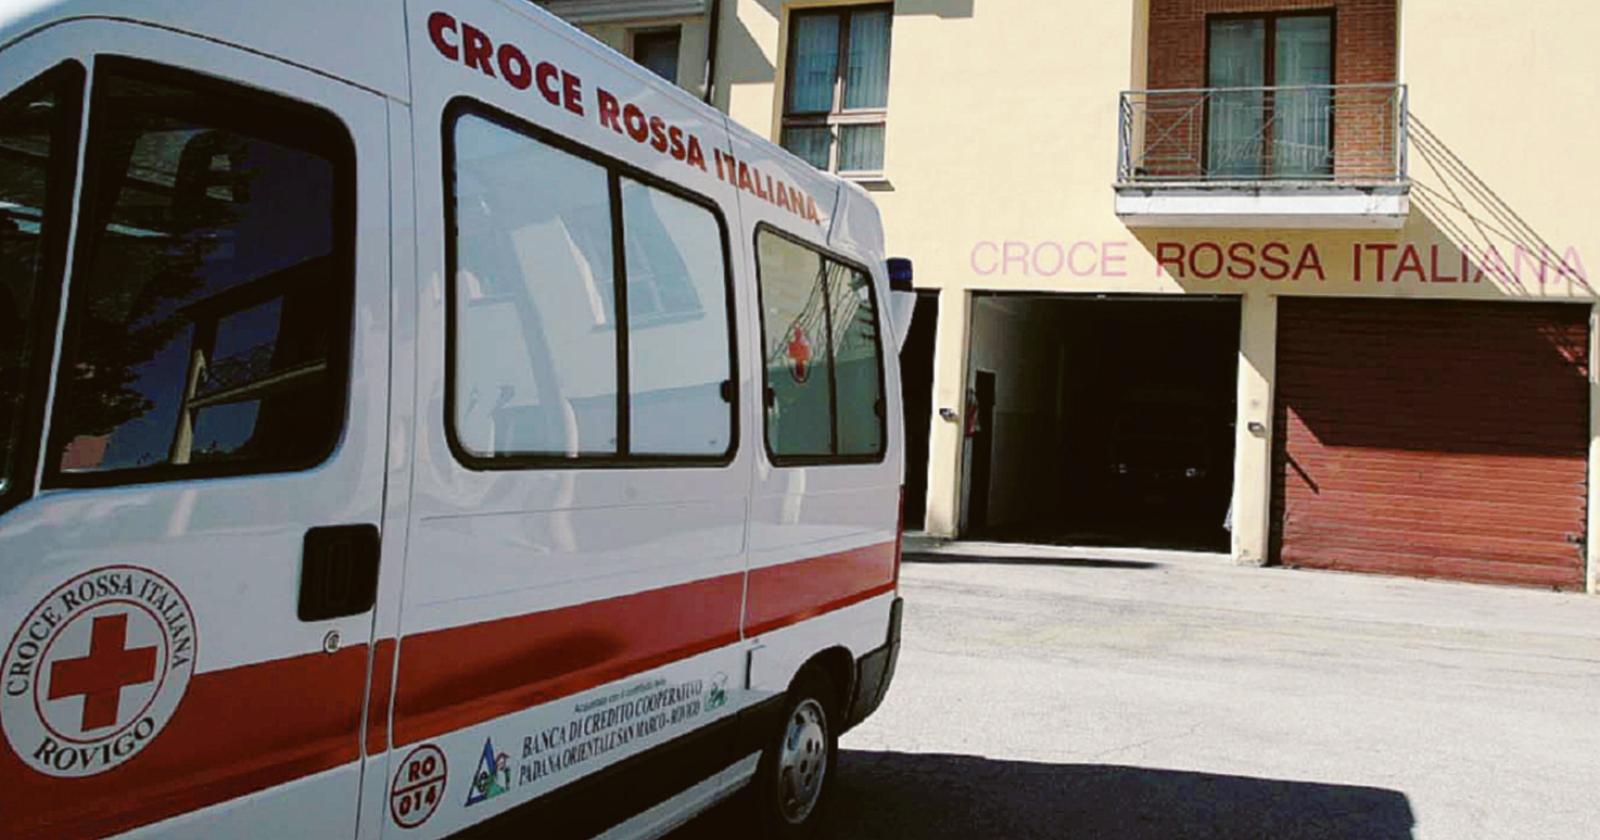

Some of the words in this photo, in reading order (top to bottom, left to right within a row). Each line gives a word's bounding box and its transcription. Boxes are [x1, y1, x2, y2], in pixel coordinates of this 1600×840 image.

[427, 11, 584, 118] CROCE
[596, 86, 708, 173] ROSSA
[714, 148, 822, 227] ITALIANA
[970, 240, 1128, 278] CROCE
[1155, 241, 1325, 282] ROSSA
[1352, 243, 1587, 285] ITALIANA
[7, 606, 62, 698] CROCE
[61, 573, 134, 604] ROSSA
[138, 576, 193, 670] ITALIANA
[33, 716, 156, 772] ROVIGO
[522, 727, 567, 758] BANCA
[568, 718, 583, 741] DI
[584, 702, 635, 736] CREDITO
[635, 680, 703, 714] COOPERATIVO
[407, 755, 437, 782] RO
[519, 752, 561, 786] PADANA
[617, 725, 637, 745] SAN
[398, 787, 438, 817] 014
